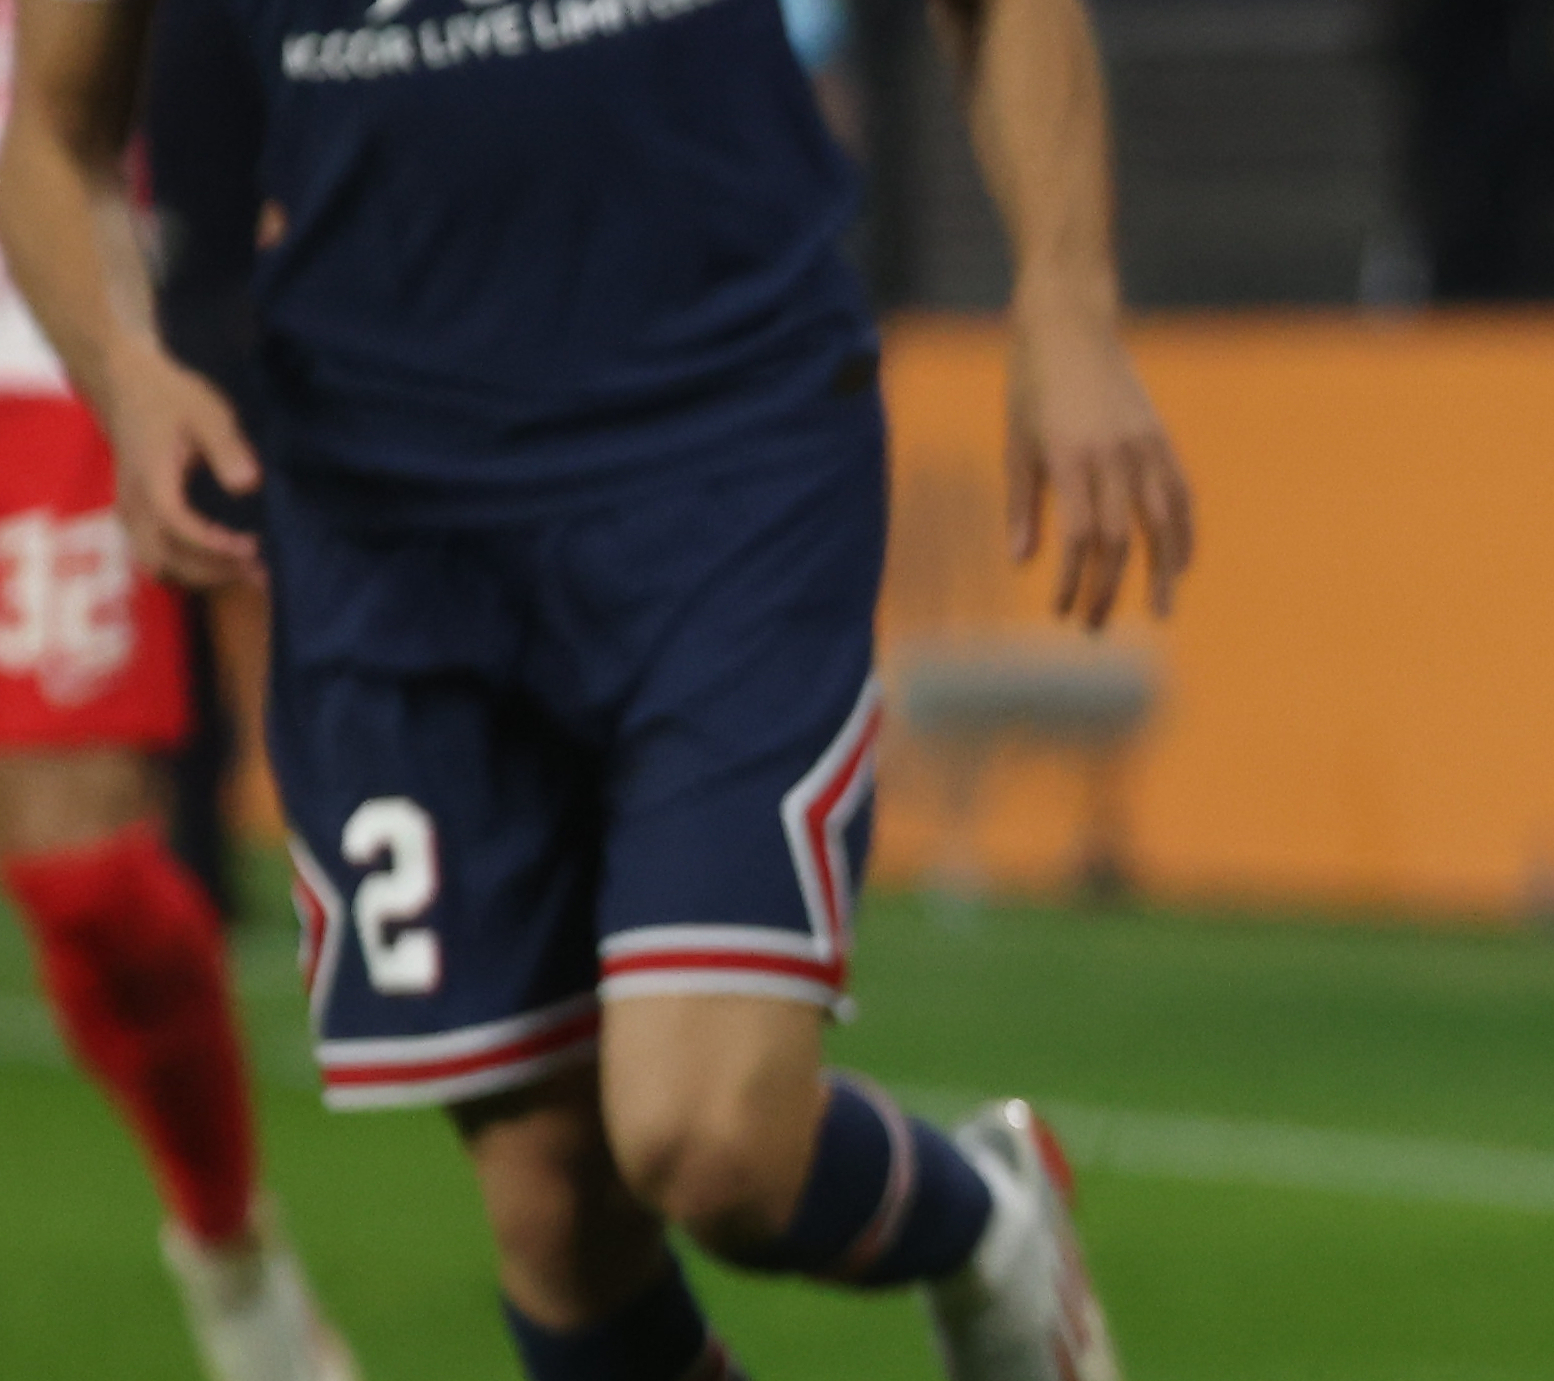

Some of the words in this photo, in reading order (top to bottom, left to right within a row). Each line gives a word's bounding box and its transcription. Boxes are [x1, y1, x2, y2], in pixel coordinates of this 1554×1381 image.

[419, 3, 527, 68] LIVE
[0, 505, 136, 667] 32
[340, 795, 442, 996] 2
